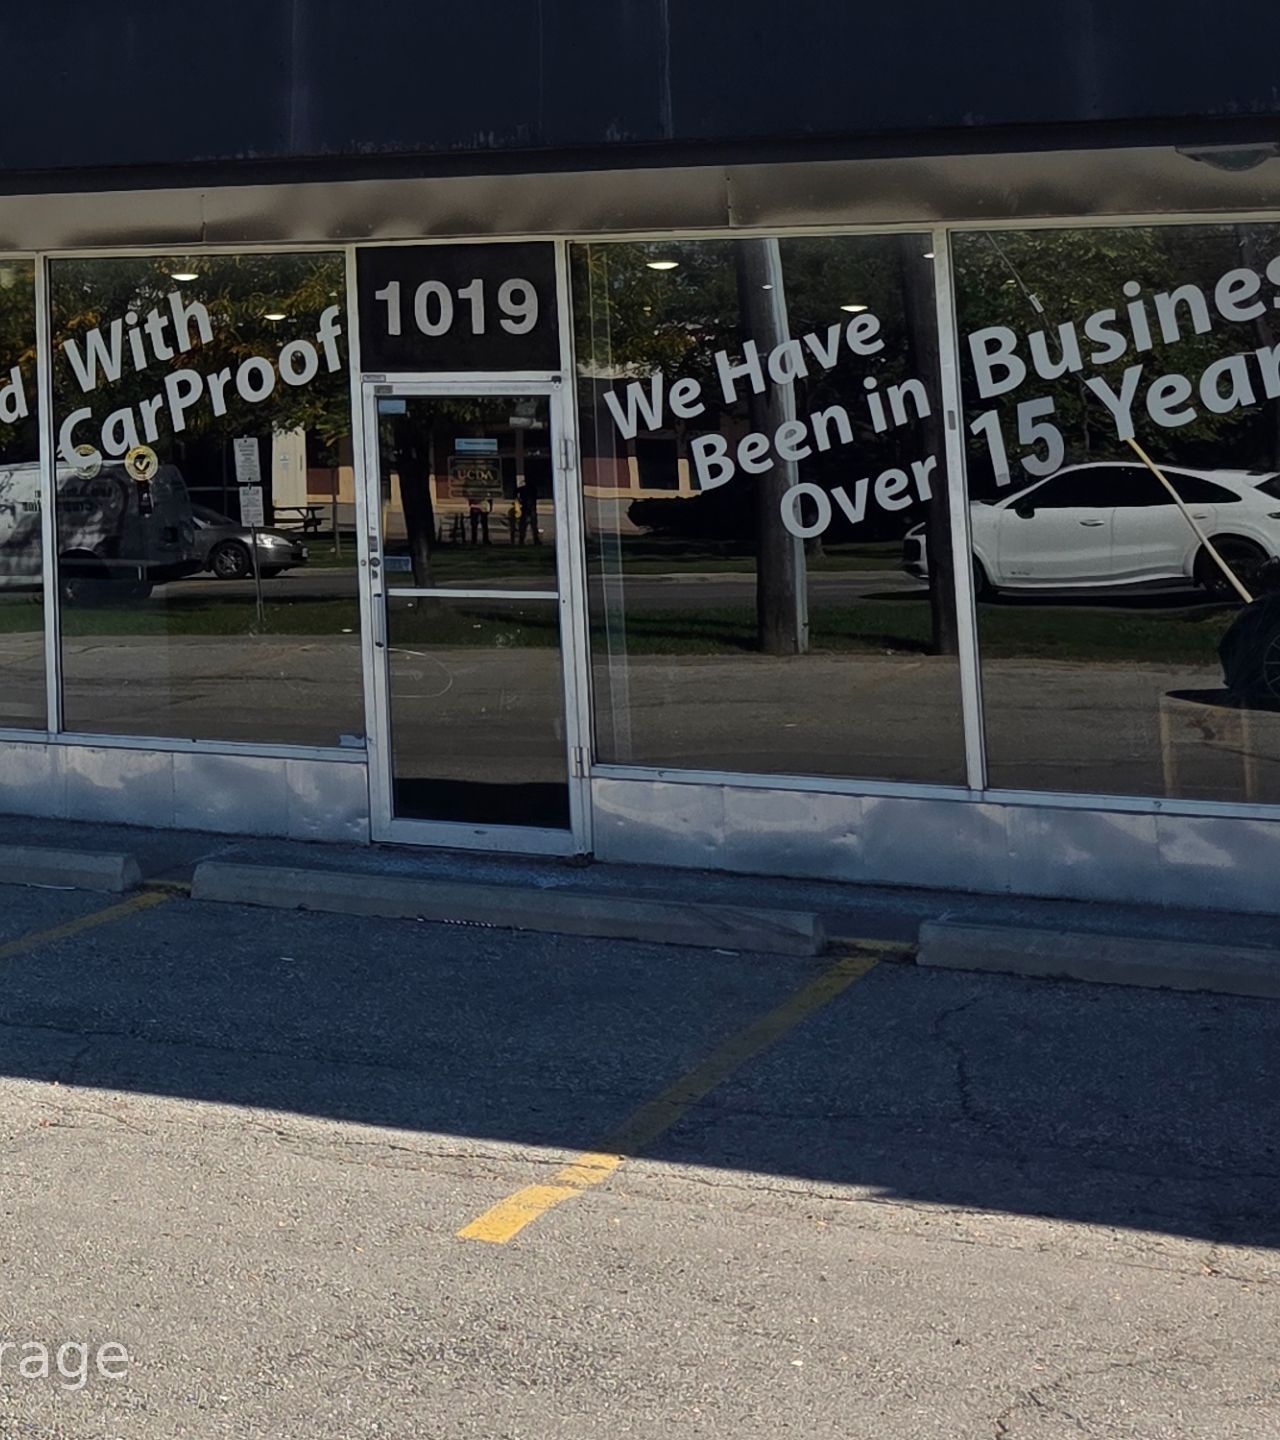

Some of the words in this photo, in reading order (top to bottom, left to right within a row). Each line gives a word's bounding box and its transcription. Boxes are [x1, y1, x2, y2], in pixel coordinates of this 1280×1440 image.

[63, 291, 214, 395] With
[375, 278, 540, 337] 1019
[55, 305, 343, 469] CarProof
[603, 380, 705, 440] We
[717, 312, 886, 406] Have
[690, 403, 846, 492] Been
[865, 375, 931, 435] in
[780, 453, 939, 540] Over
[969, 396, 1066, 488] 15
